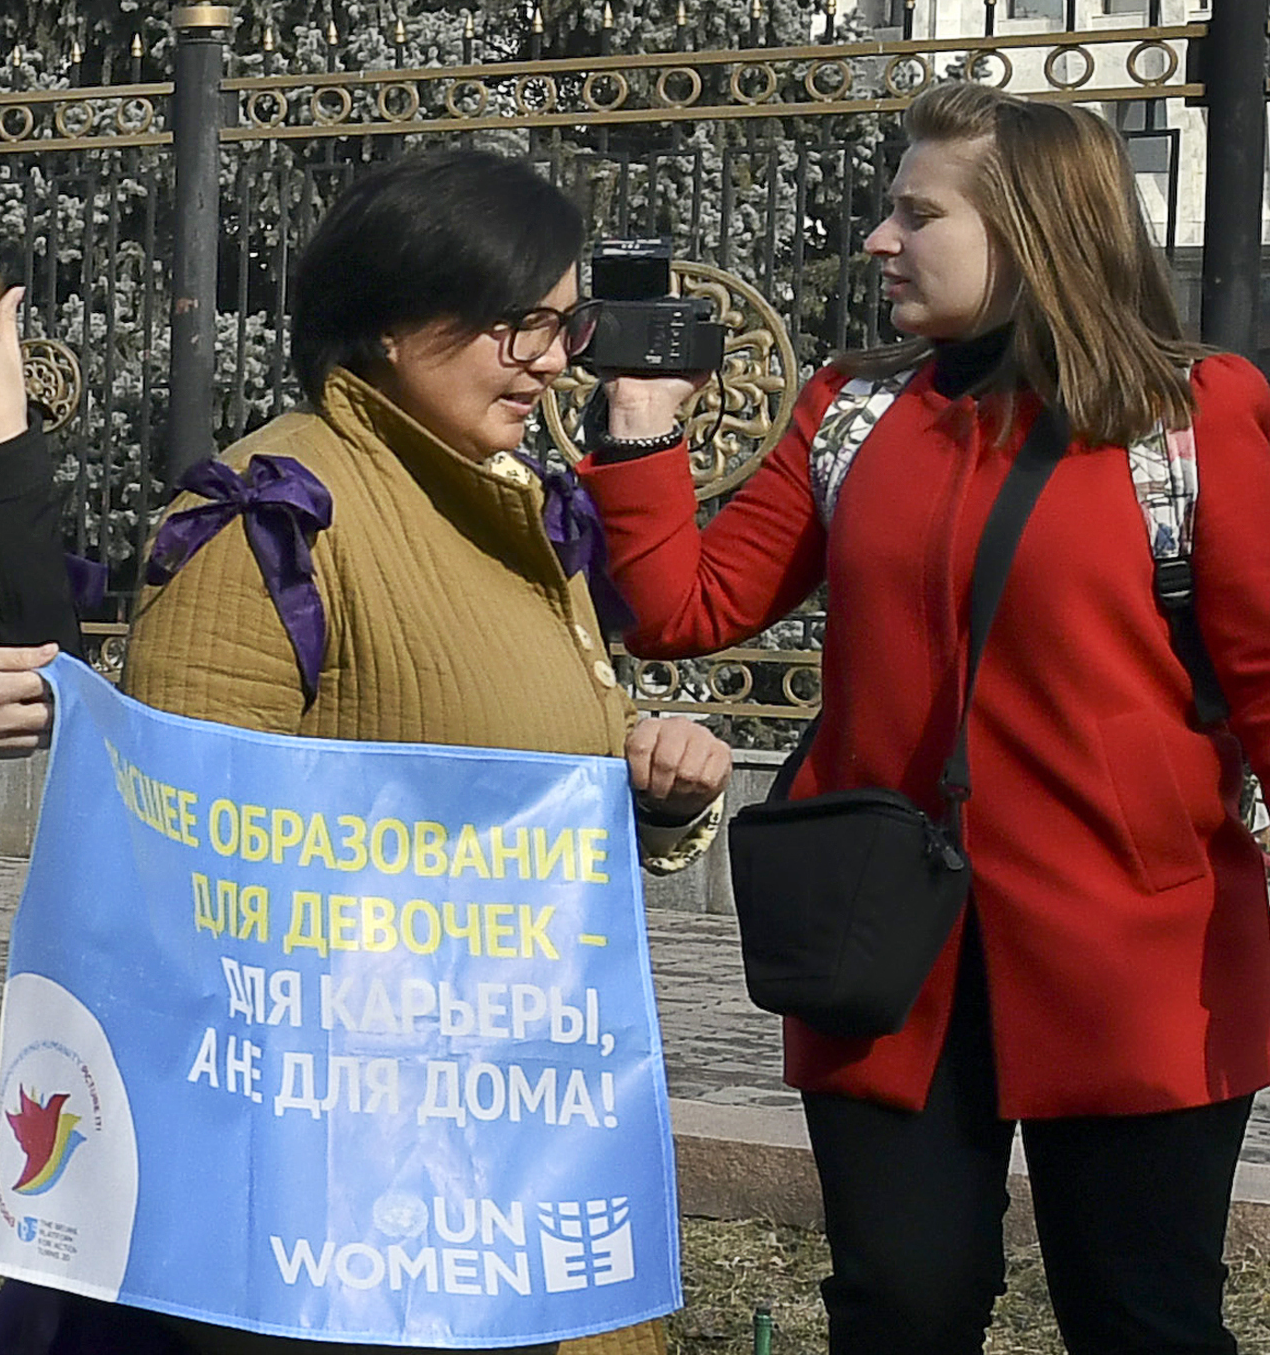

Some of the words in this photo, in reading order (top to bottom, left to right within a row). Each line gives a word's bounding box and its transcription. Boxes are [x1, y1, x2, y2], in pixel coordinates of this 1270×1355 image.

[207, 797, 610, 885] ОБРАЗОВАНИЕ
[191, 871, 269, 943] ДЛЯ
[283, 890, 560, 960] ДЕВОЧЕК
[221, 956, 303, 1028] ДЛЯ
[320, 975, 616, 1056] КАРЬЕРЫ,
[187, 1026, 220, 1089] А
[226, 1034, 263, 1104] НЕ
[274, 1053, 401, 1120] ДЛЯ
[416, 1057, 619, 1130] ДОМА!
[433, 1194, 527, 1246] UN
[270, 1233, 533, 1296] WOMEN
